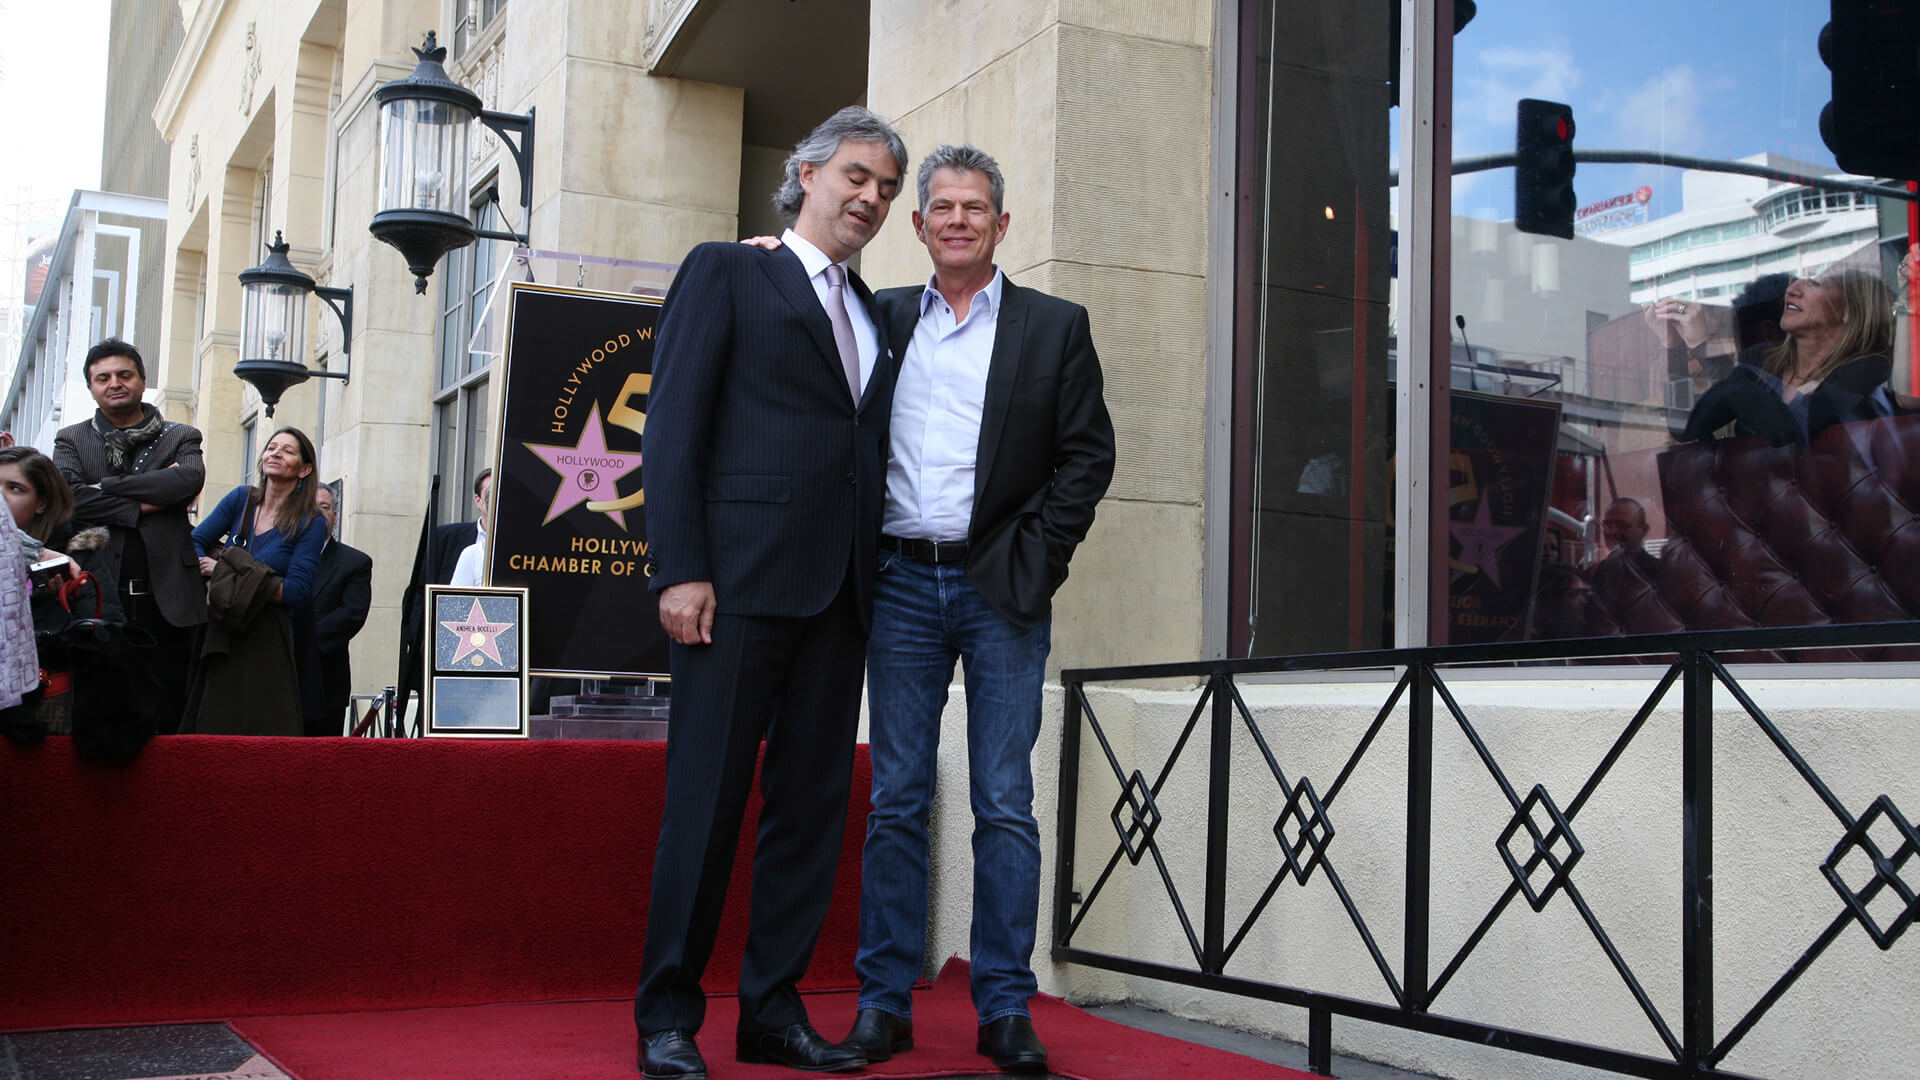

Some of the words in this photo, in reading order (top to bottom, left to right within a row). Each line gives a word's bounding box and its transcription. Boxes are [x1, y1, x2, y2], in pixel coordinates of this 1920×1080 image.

[551, 333, 631, 433] HOLLYWOOD
[556, 455, 625, 469] HOLLYWOOD
[571, 537, 649, 556] HOLLYW
[509, 554, 602, 575] CHAMBER
[610, 560, 636, 577] OF
